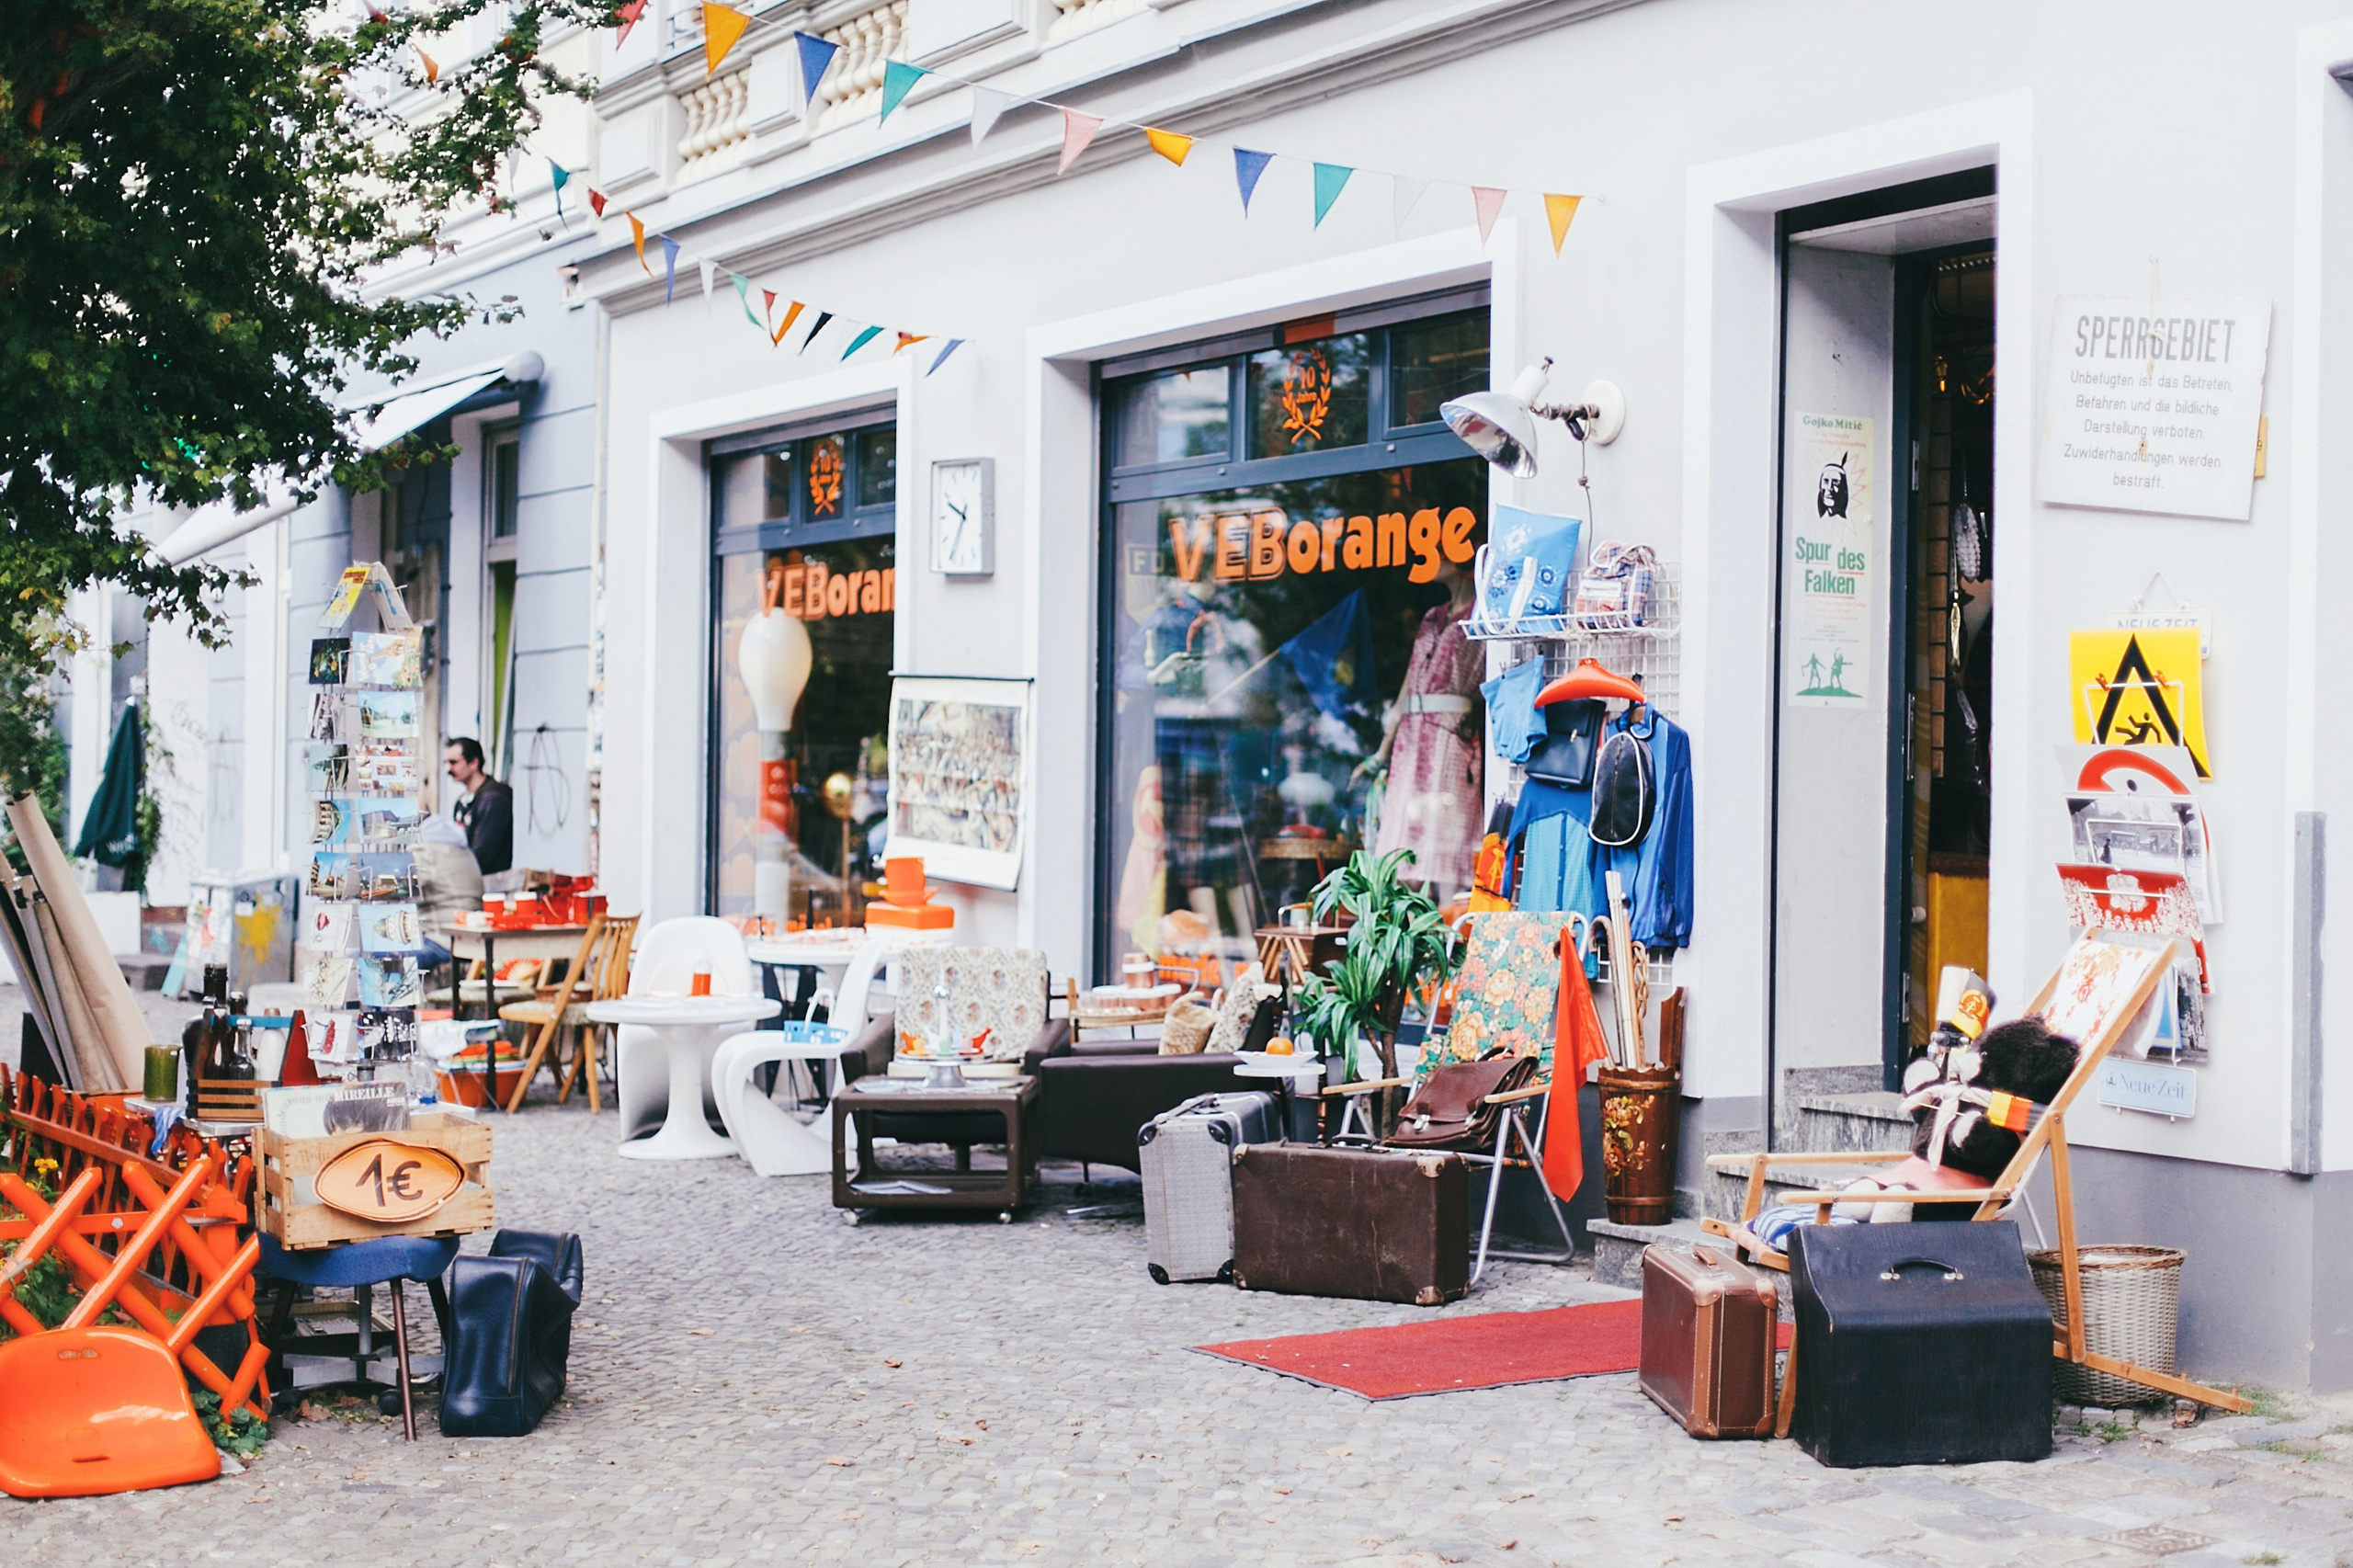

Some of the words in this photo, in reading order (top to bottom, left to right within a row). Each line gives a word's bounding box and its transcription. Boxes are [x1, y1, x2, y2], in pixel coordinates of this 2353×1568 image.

[2075, 315, 2236, 363] SPERRGEBIET
[1299, 366, 1316, 390] 10
[2070, 369, 2134, 389] Unbefugten
[2138, 371, 2154, 387] ist
[2158, 373, 2178, 389] das
[2183, 374, 2233, 392] Betreten,
[2075, 394, 2127, 410] Befahren
[2131, 398, 2151, 412] und
[2154, 398, 2171, 413] die
[2175, 399, 2220, 416] bildliche
[1802, 415, 1834, 429] Gojko
[2084, 418, 2148, 439] Darstellung
[2152, 425, 2206, 439] verboten.
[2063, 443, 2174, 468] Zuwiderhandlungen
[2178, 453, 2222, 469] werden
[2113, 472, 2165, 489] bestraft.
[1167, 506, 1477, 585] VEBorange
[1794, 536, 1832, 564] Spur
[1837, 546, 1865, 571] des
[1804, 569, 1856, 596] Falken
[334, 1085, 395, 1102] MIREILLE
[2119, 1072, 2156, 1095] Neue
[2156, 1078, 2187, 1100] Zeit
[356, 1153, 423, 1208] 1€
